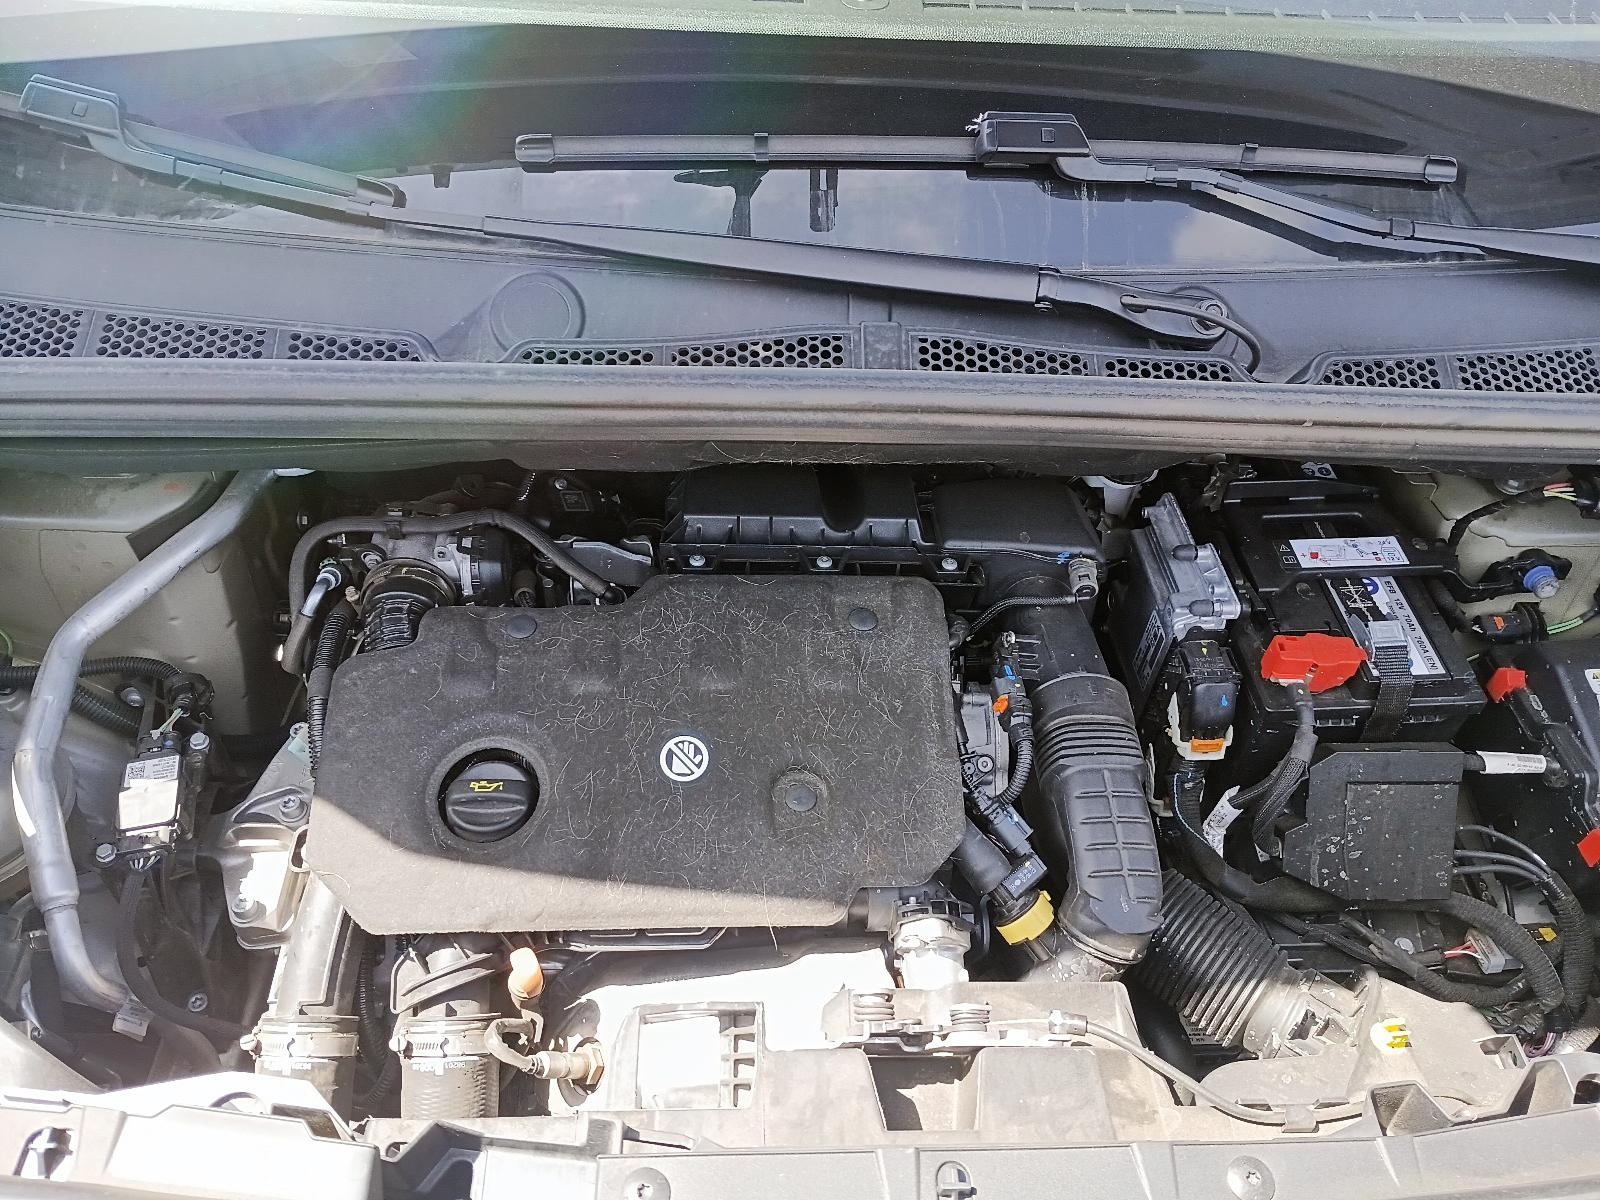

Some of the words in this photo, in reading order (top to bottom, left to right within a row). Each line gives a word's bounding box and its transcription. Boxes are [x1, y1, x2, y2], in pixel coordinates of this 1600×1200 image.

[1384, 580, 1397, 594] EFB
[1394, 598, 1406, 611] 12V
[1403, 614, 1417, 632] 70Ah
